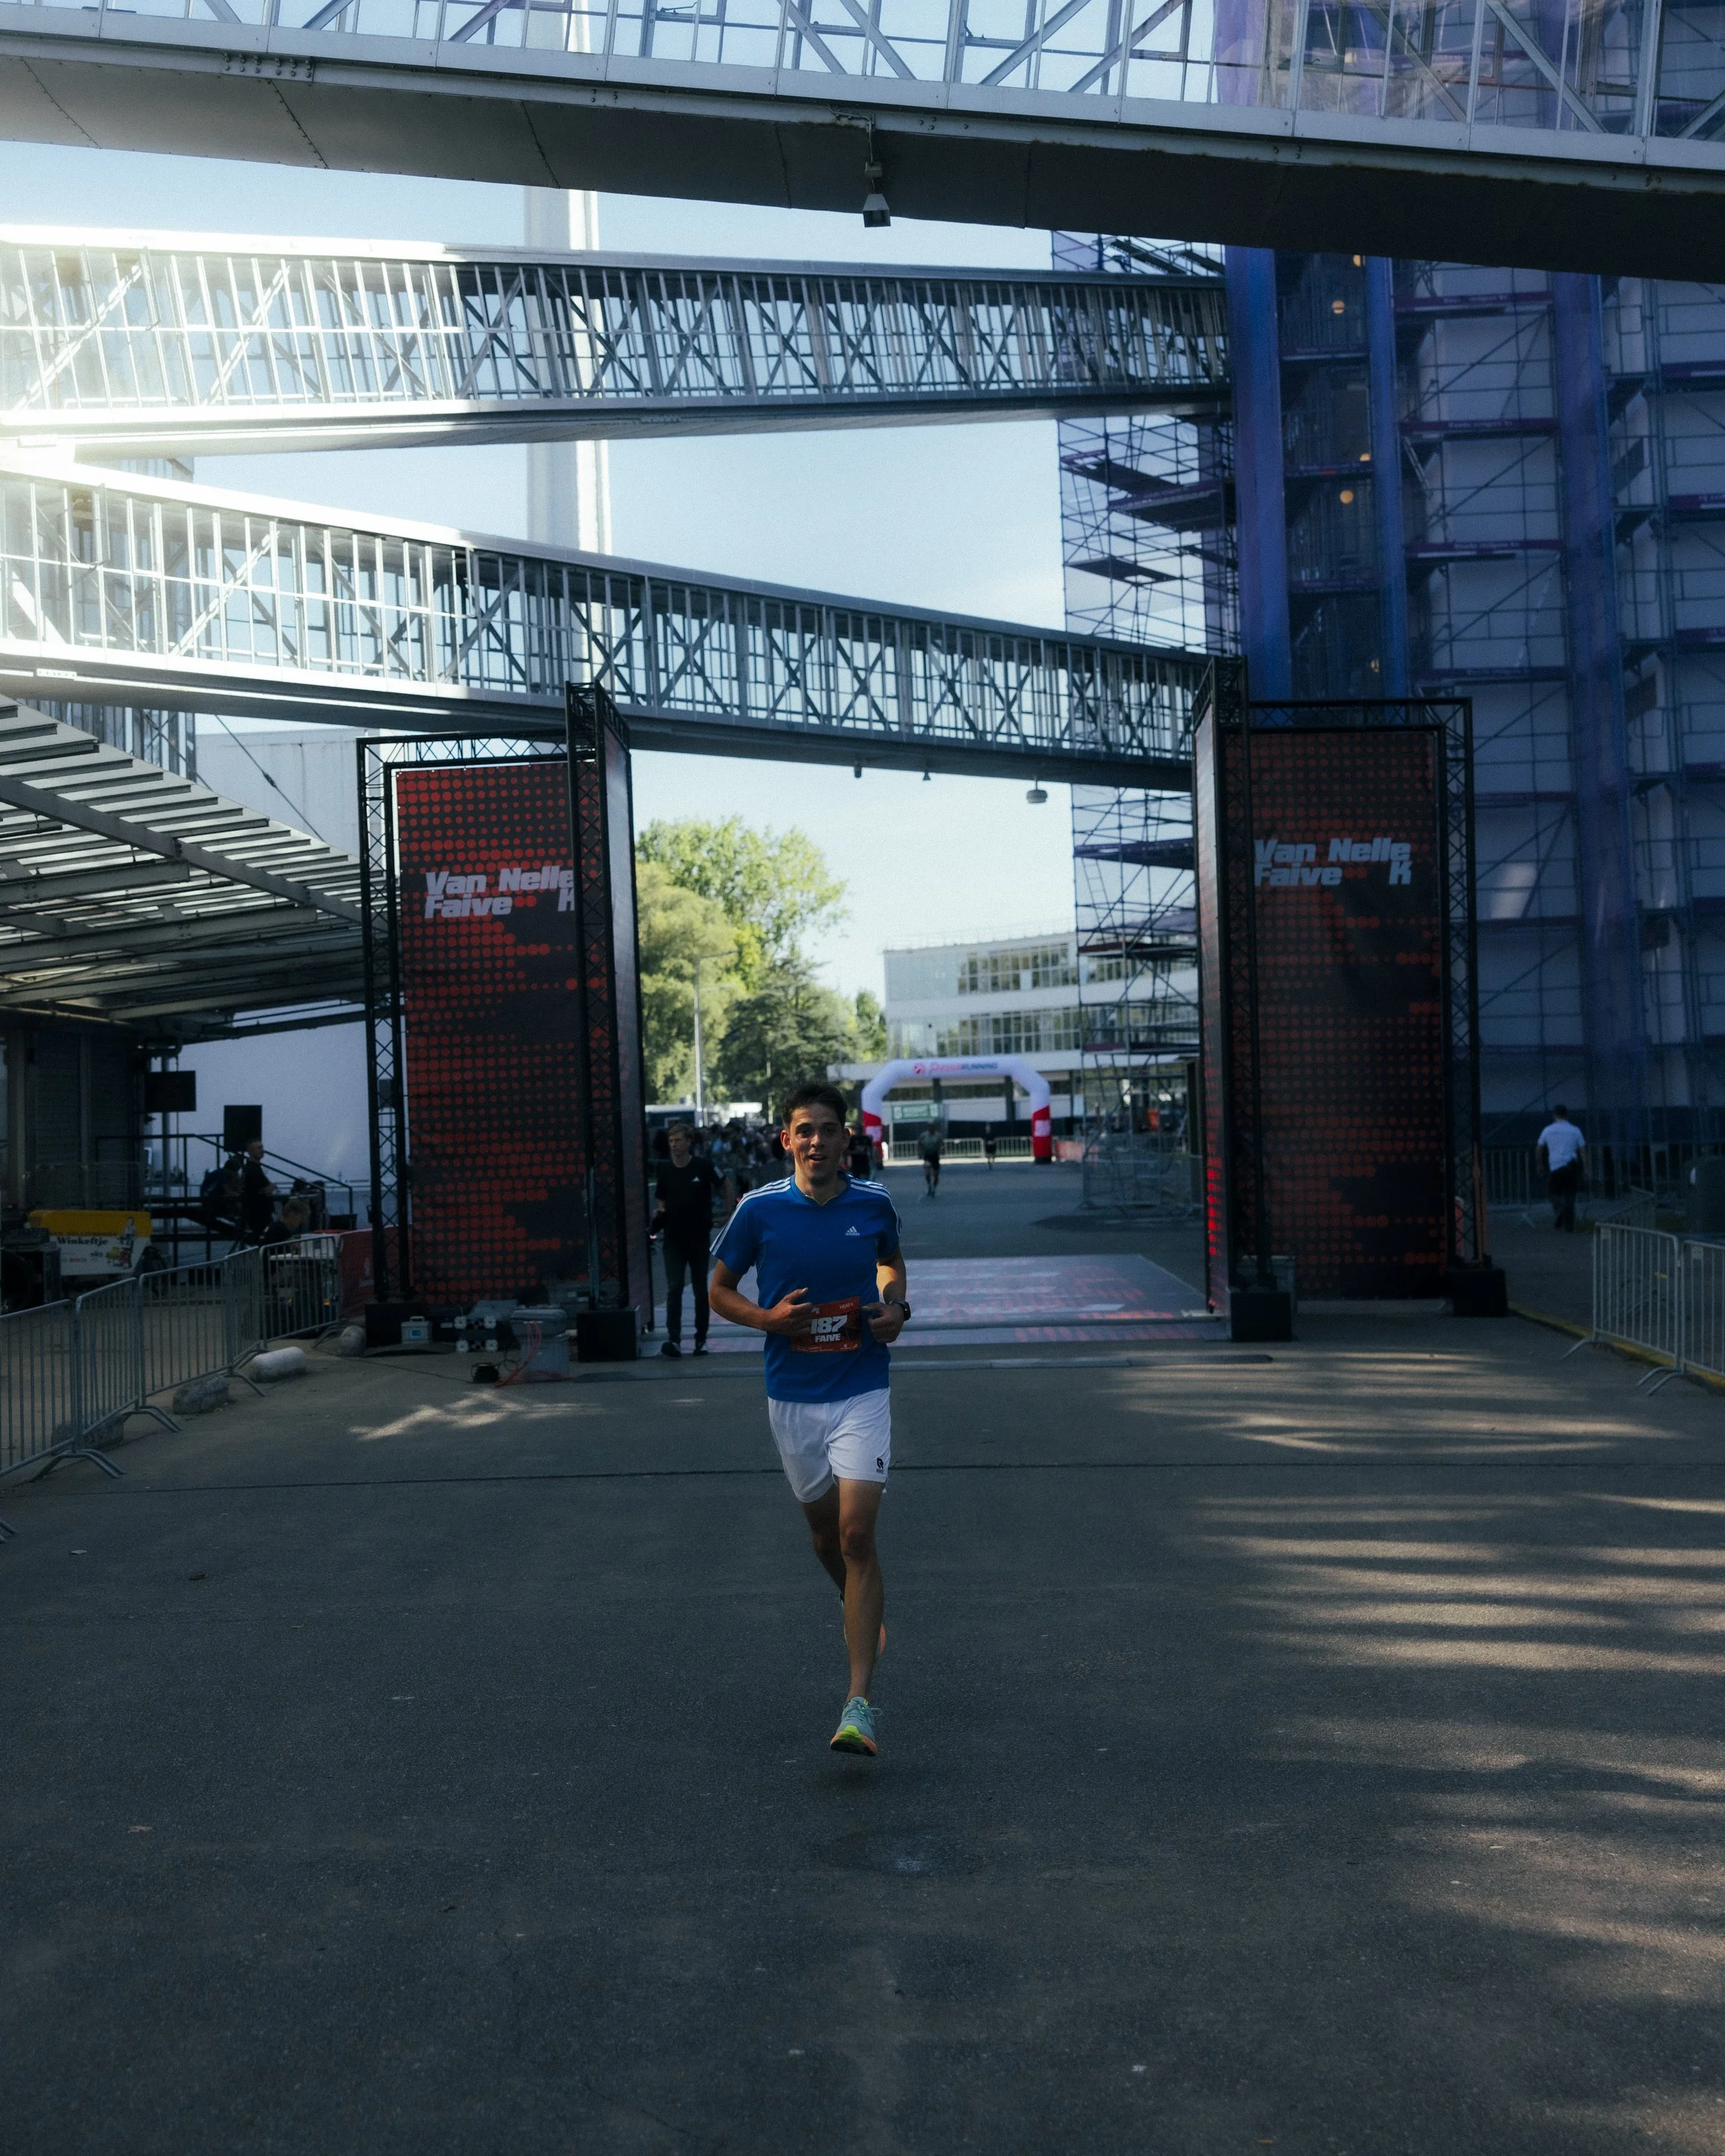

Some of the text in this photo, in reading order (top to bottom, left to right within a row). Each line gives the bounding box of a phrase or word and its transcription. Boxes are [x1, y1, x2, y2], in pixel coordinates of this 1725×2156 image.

[1254, 837, 1411, 863] Van Nelle
[426, 865, 574, 895] Van Nelle
[1254, 861, 1412, 886] Faive K
[425, 893, 513, 918] Faive
[811, 1314, 847, 1335] 187
[814, 1333, 841, 1342] FAIVE
